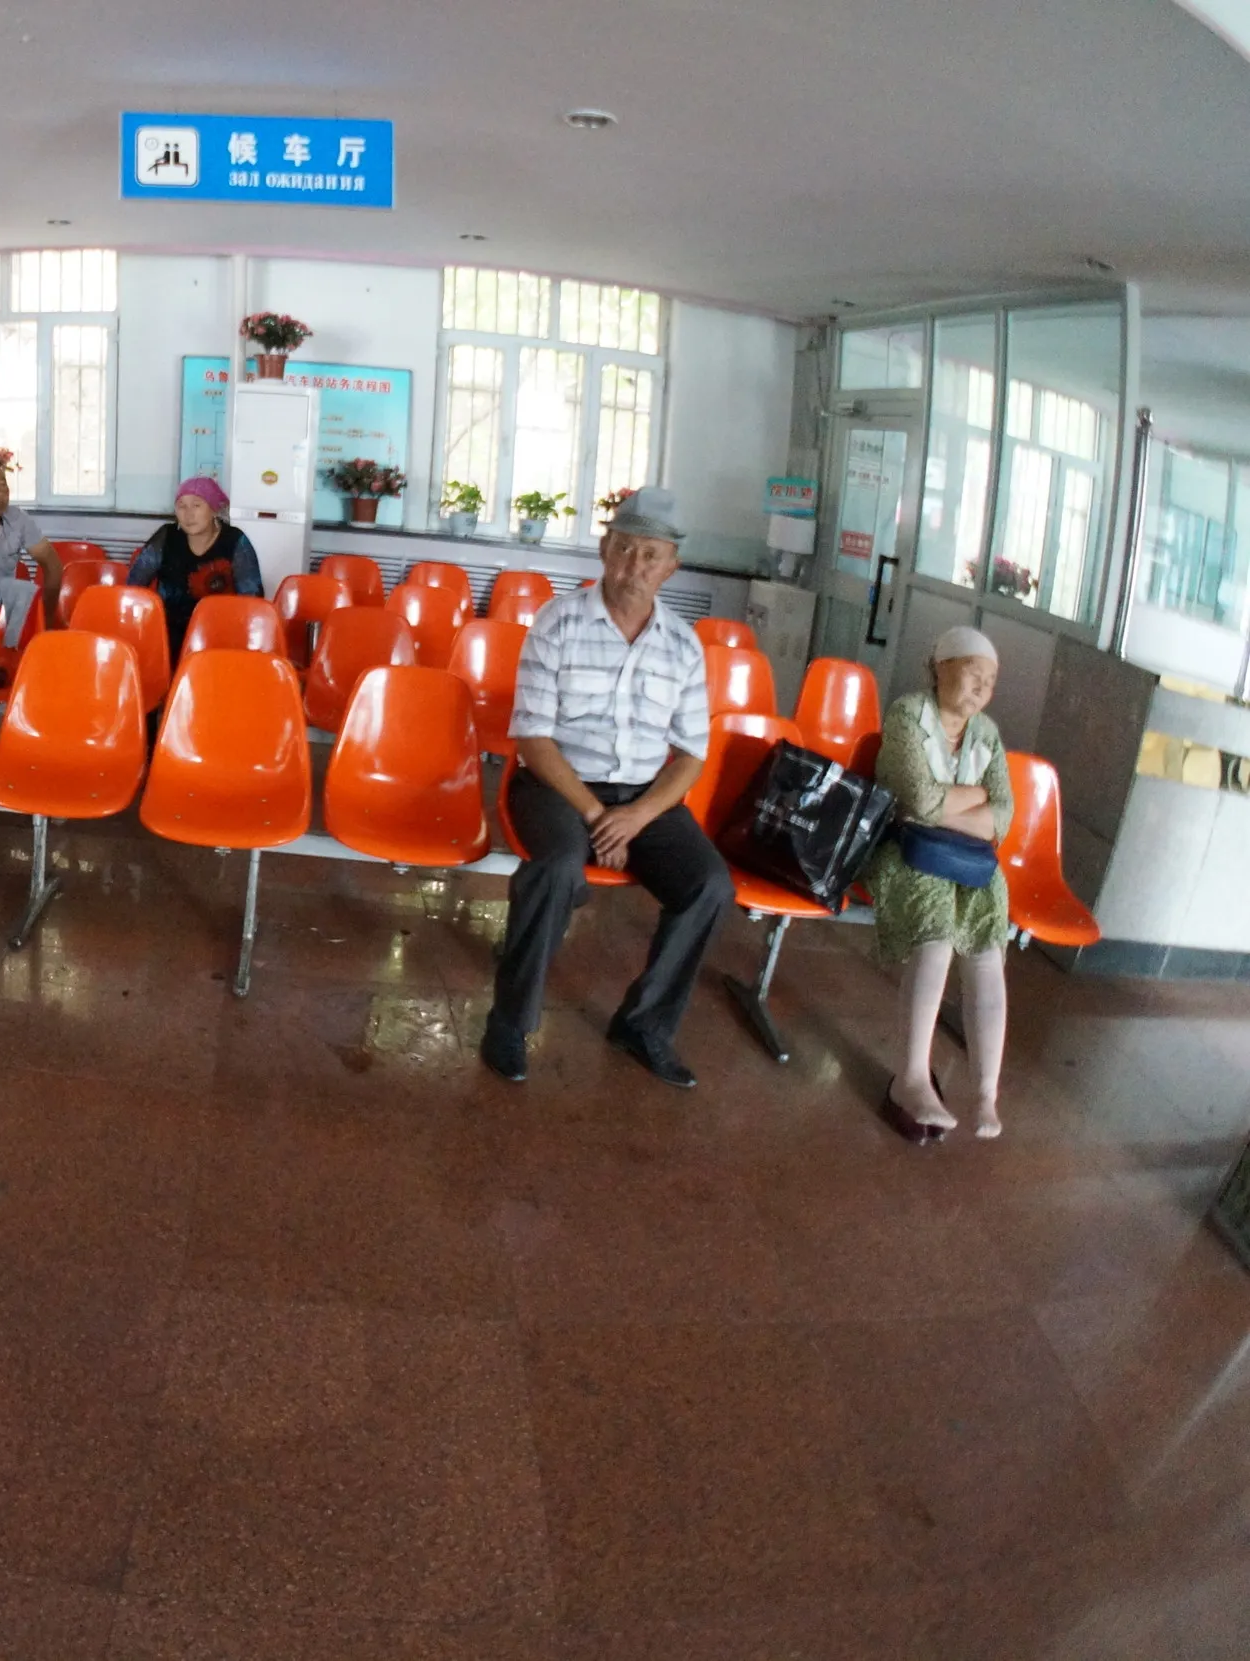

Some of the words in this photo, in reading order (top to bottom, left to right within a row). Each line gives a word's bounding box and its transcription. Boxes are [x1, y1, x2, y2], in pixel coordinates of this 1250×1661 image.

[228, 132, 366, 168] 候车厅
[228, 171, 260, 188] зал
[265, 172, 366, 192] ожидания
